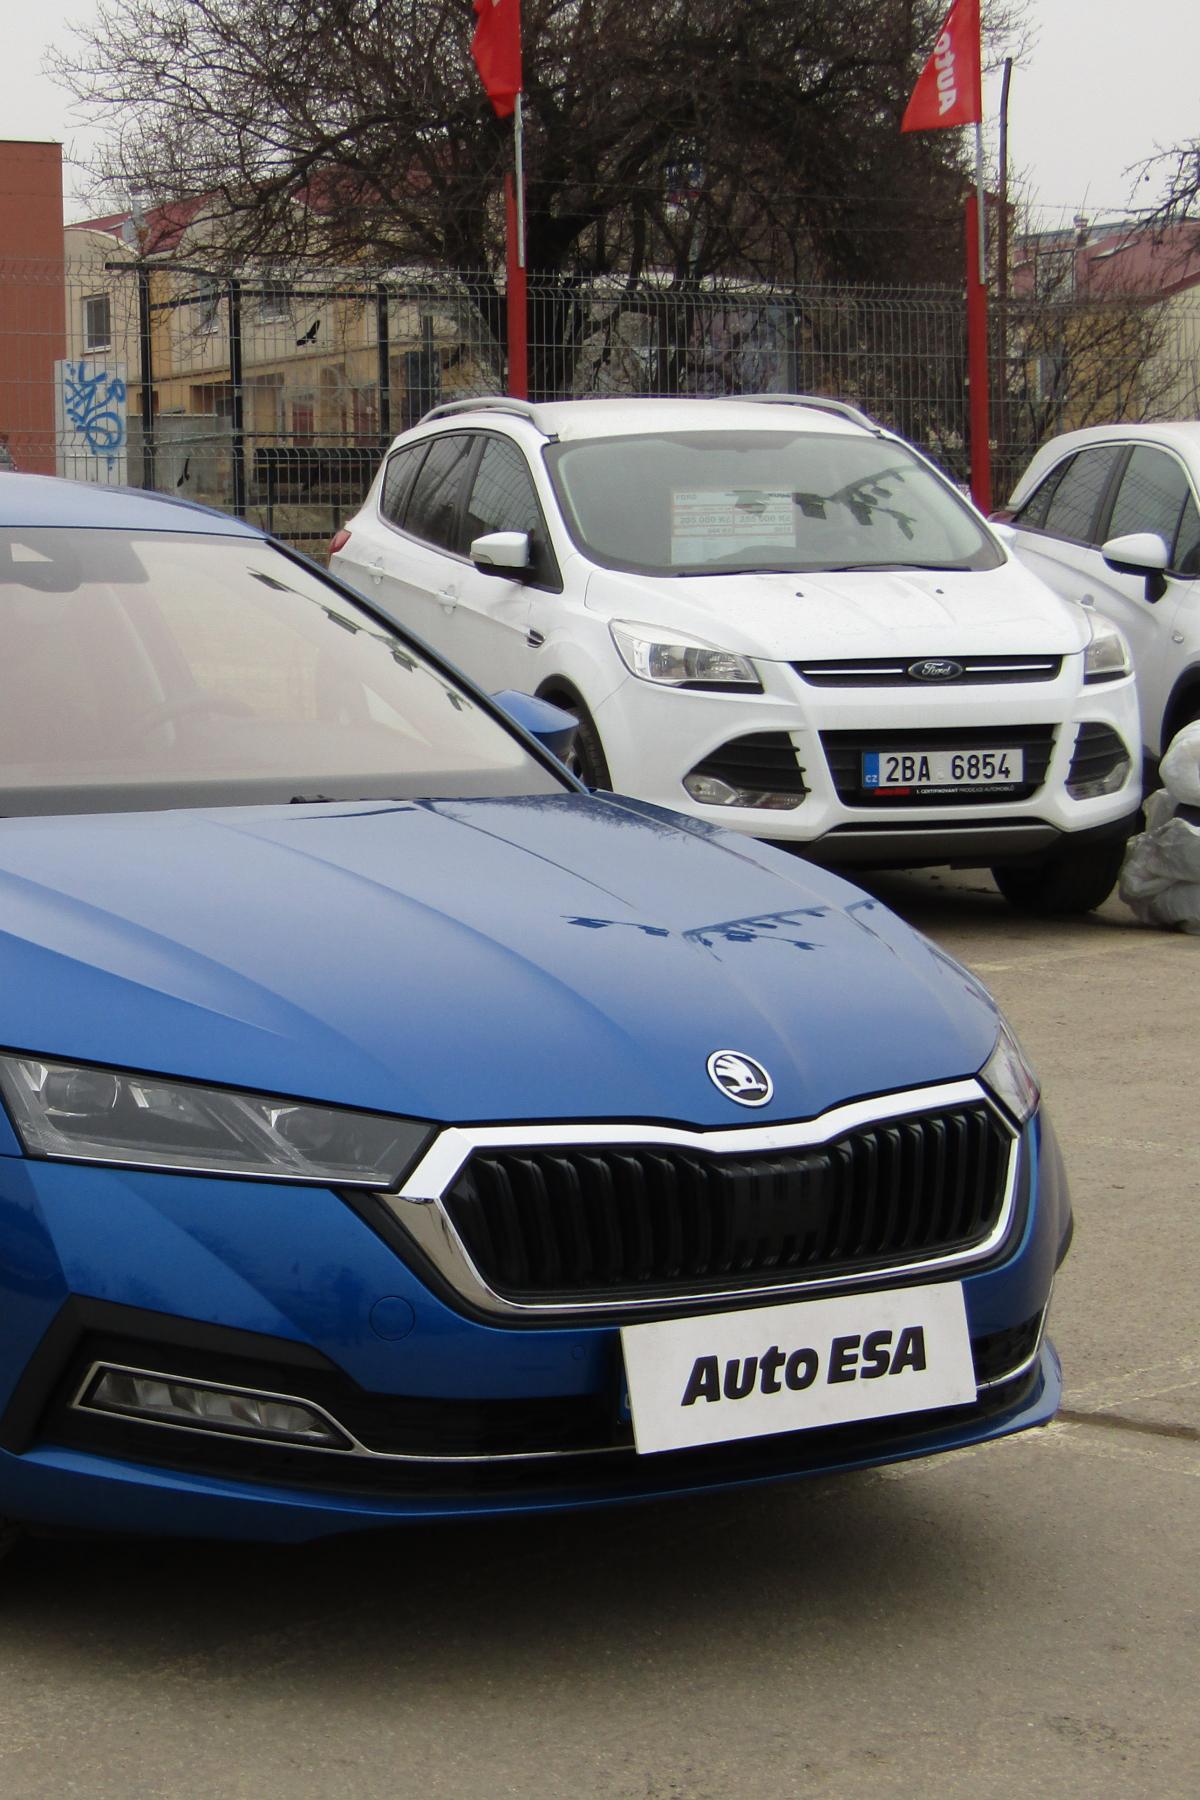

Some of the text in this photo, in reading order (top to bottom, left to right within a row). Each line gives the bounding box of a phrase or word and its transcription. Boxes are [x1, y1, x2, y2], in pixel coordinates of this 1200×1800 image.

[921, 662, 952, 676] Ford
[865, 775, 878, 783] CZ
[886, 753, 1011, 783] 2BA 6854
[681, 1325, 927, 1406] Auto ESA
